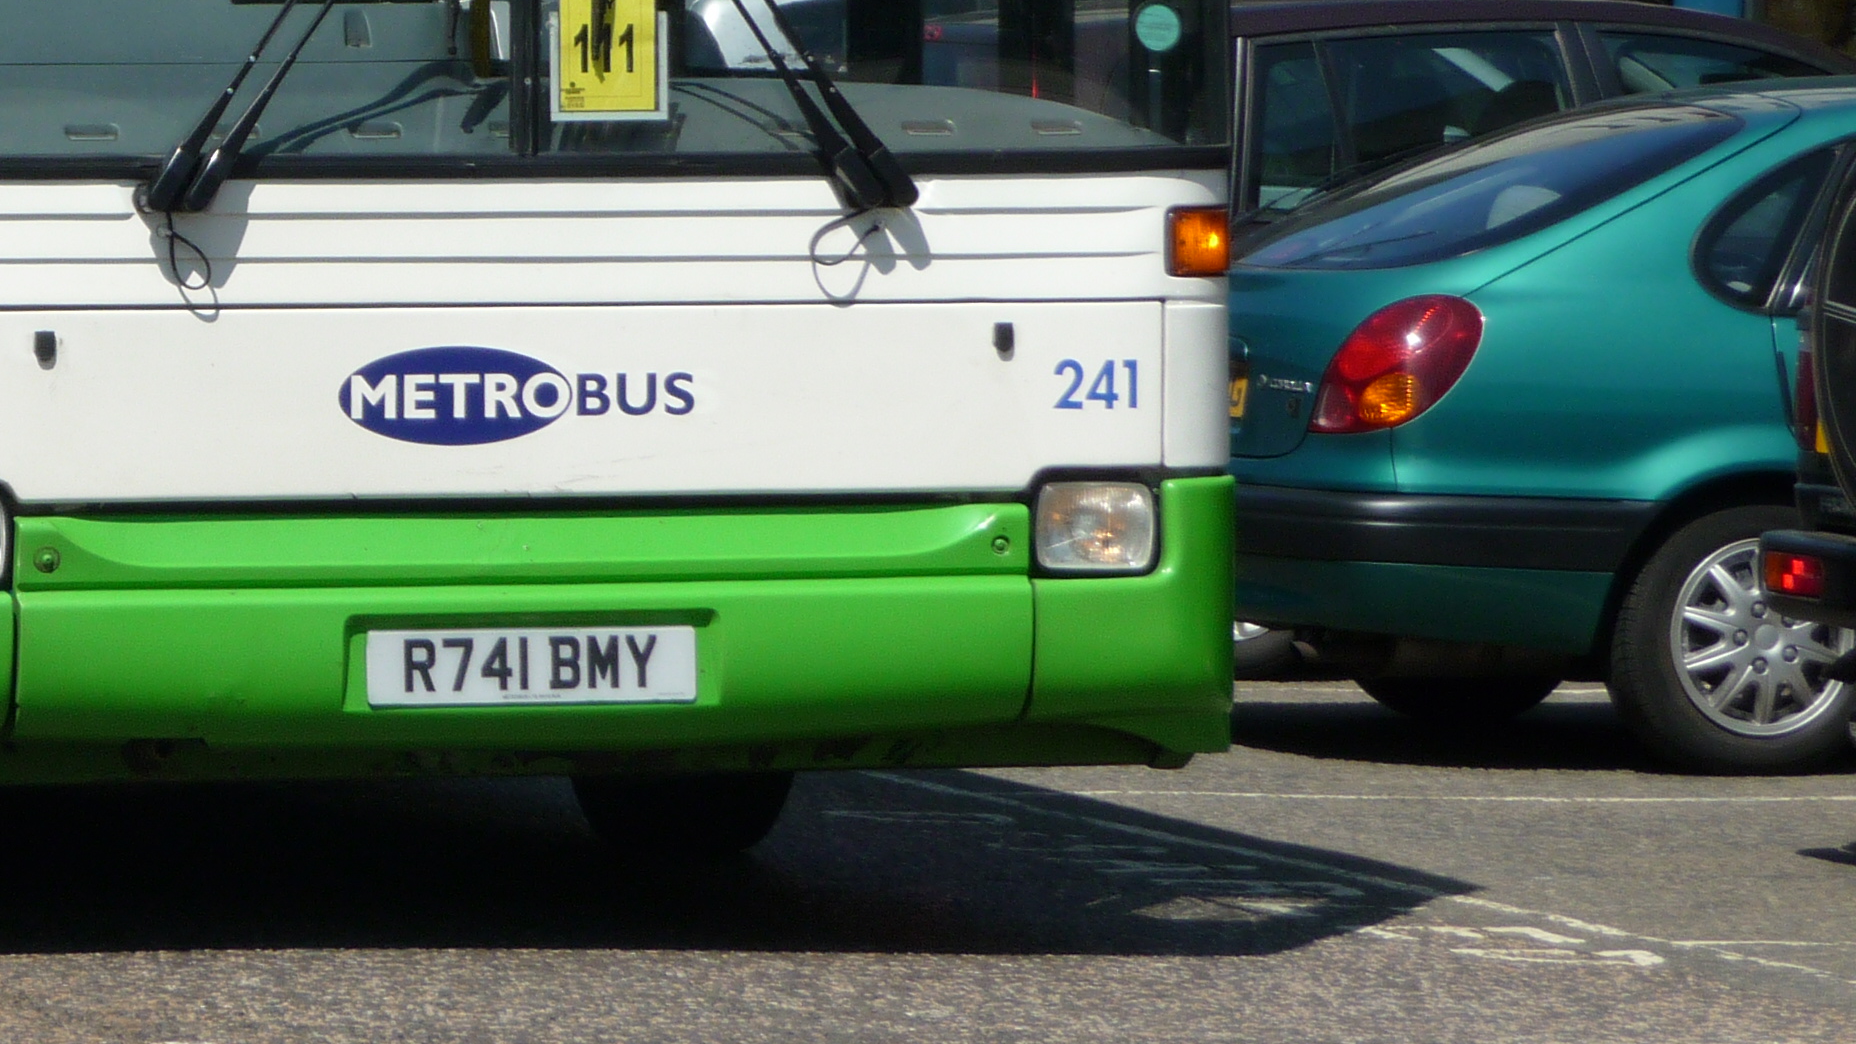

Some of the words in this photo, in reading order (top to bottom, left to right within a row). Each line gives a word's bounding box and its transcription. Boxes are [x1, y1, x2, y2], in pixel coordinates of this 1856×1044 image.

[573, 22, 635, 74] 111
[350, 371, 696, 419] METROBUS
[1052, 358, 1138, 409] 241
[403, 636, 530, 693] R741
[548, 633, 658, 690] BMY
